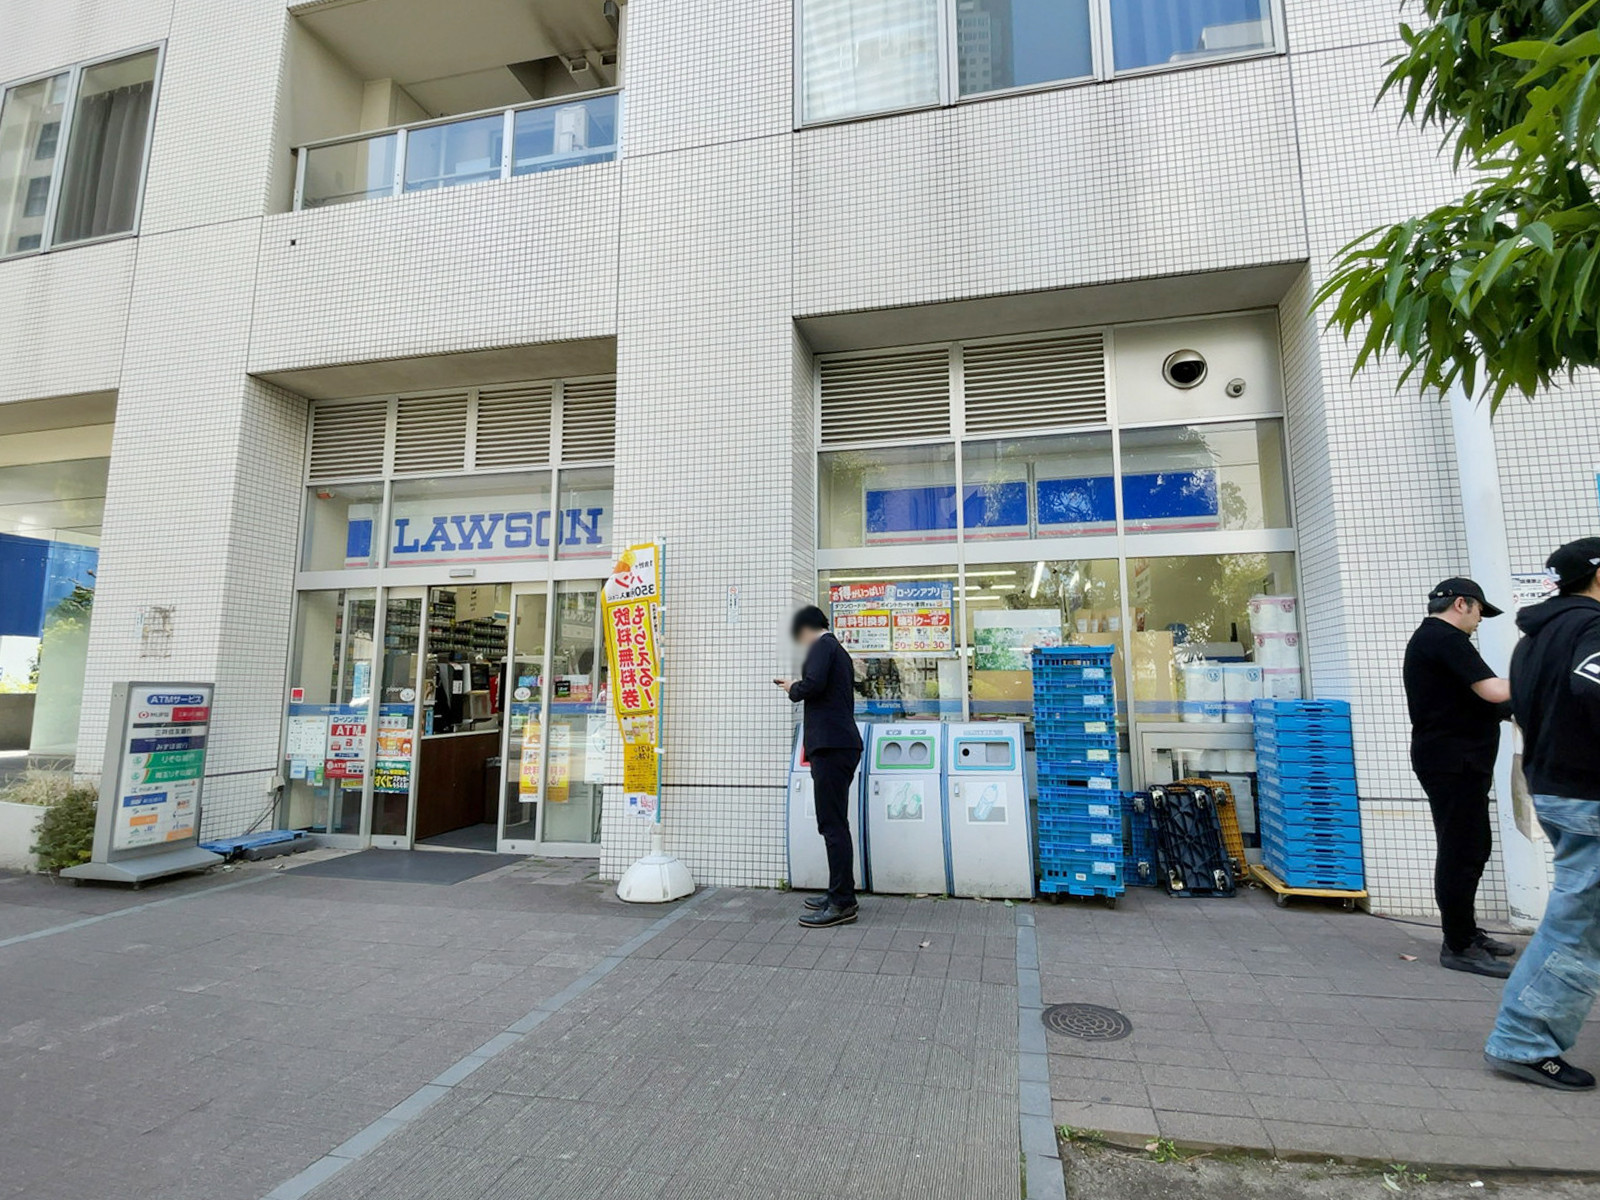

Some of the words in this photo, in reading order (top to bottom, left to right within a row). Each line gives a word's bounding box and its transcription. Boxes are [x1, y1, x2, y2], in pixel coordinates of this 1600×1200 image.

[393, 508, 603, 554] LAWSON
[896, 587, 941, 598] ローソンアプリ
[150, 695, 202, 705] ATMサービス
[335, 725, 363, 736] ATM
